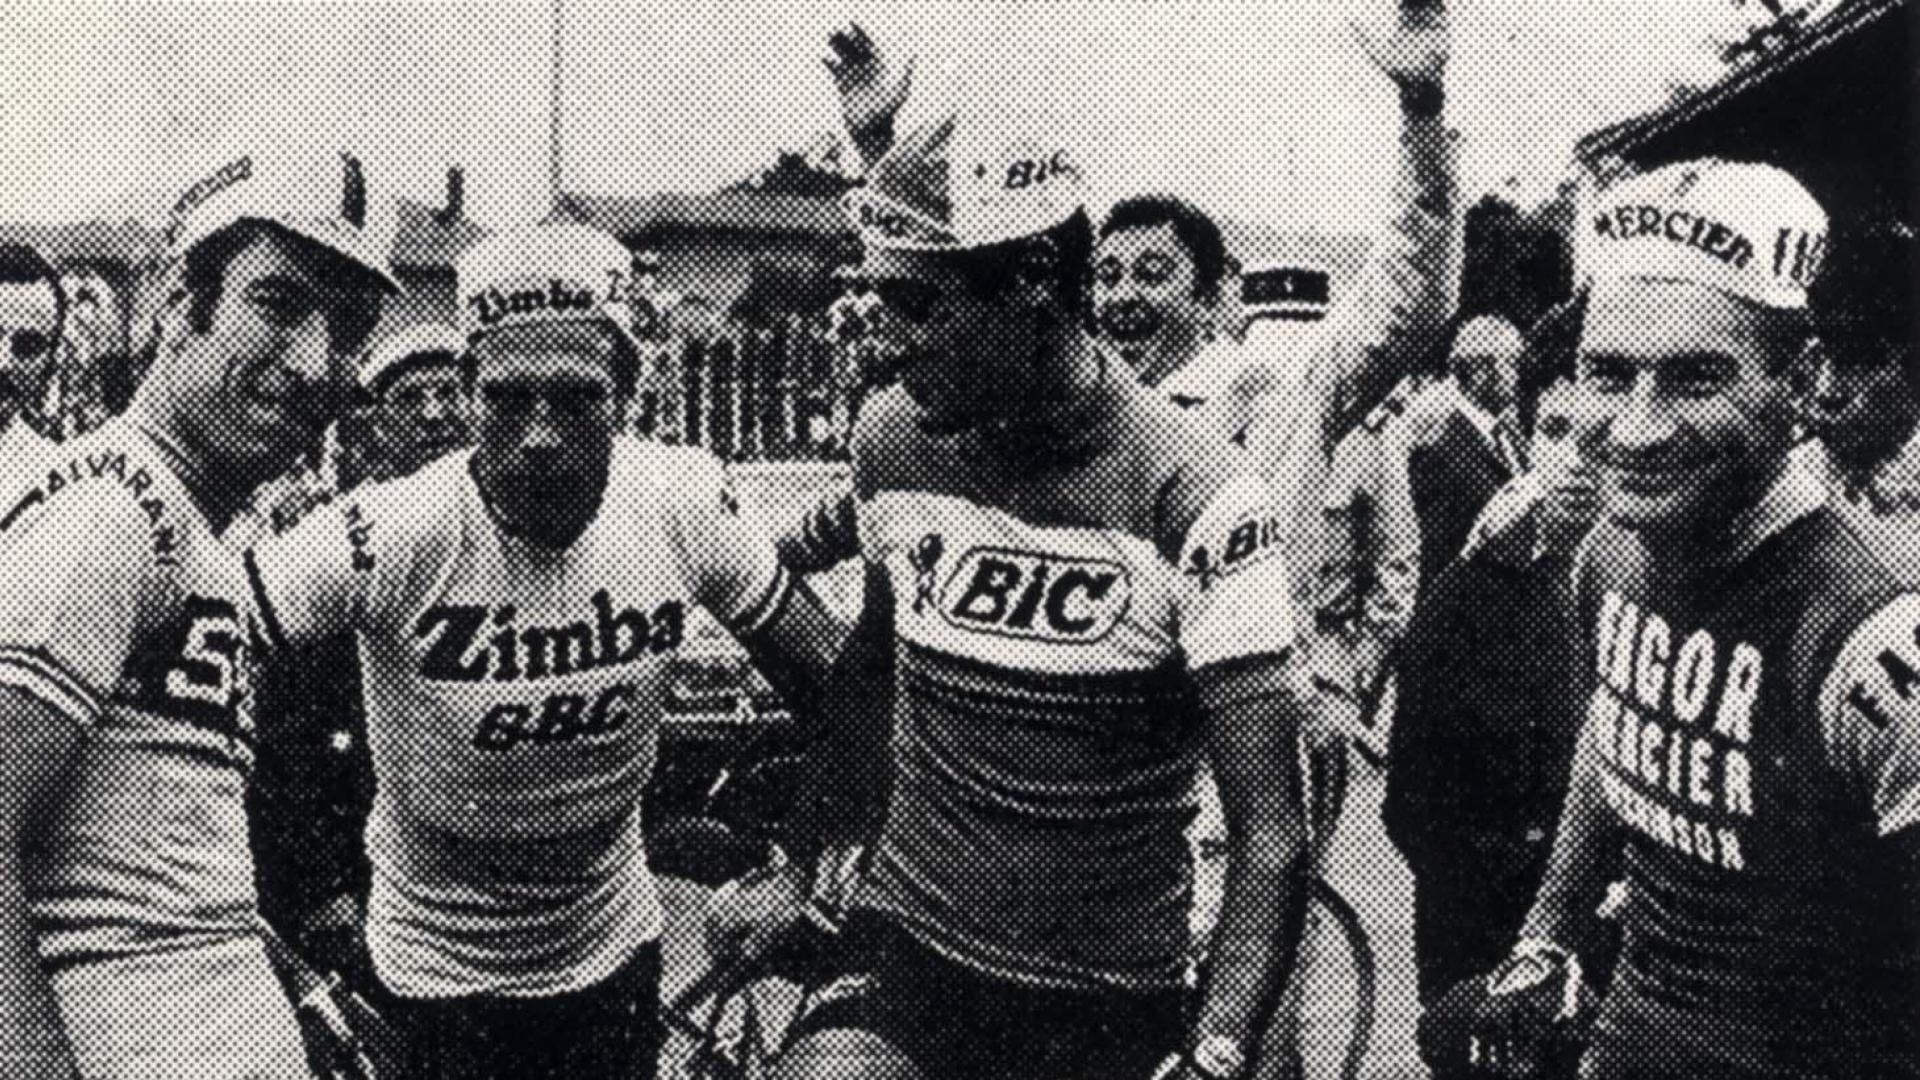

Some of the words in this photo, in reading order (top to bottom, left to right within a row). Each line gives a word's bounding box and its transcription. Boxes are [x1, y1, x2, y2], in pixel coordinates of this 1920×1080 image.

[1594, 204, 1754, 269] MERCIER
[414, 588, 683, 682] Zimba
[1847, 624, 1920, 730] FA
